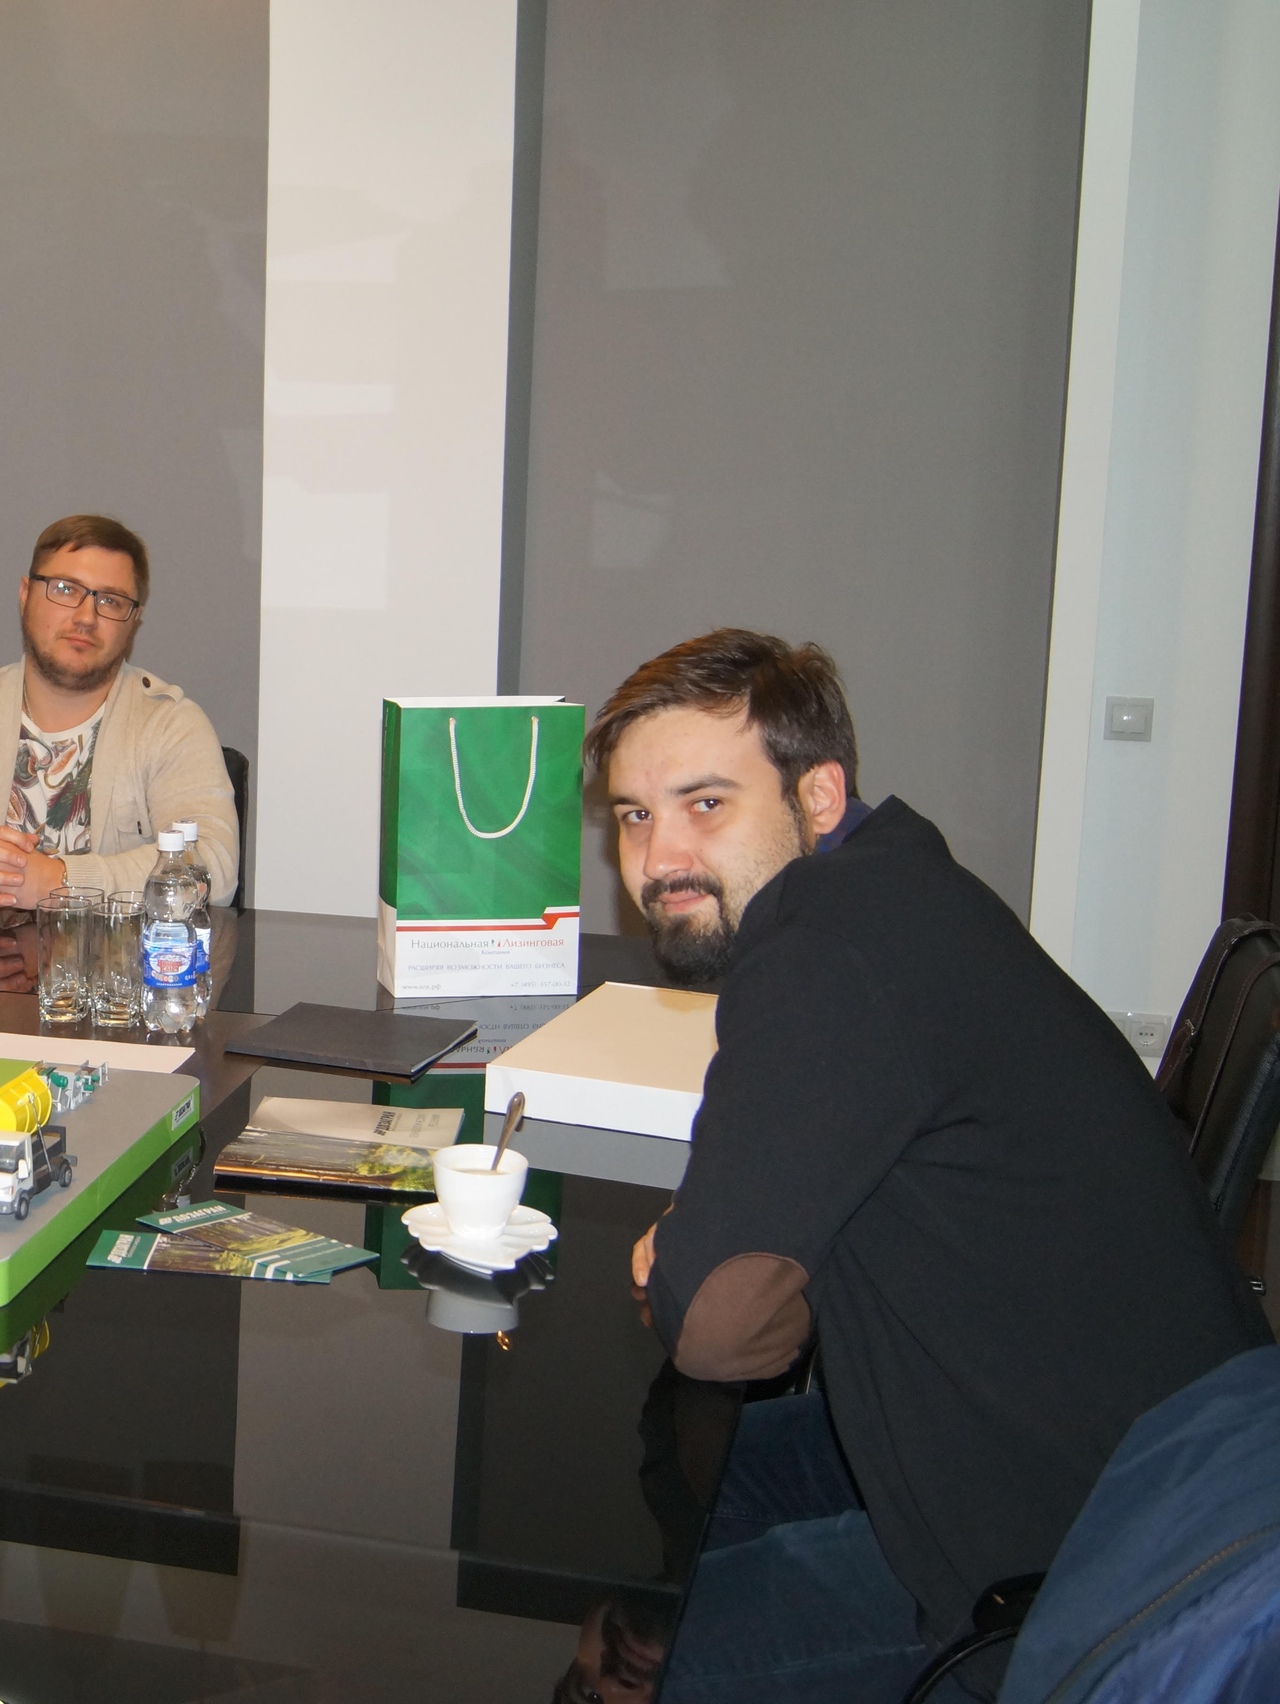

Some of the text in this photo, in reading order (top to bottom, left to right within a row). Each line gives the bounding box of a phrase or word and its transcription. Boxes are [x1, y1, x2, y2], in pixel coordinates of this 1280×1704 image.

[410, 938, 564, 950] Национальная Лизинговая
[446, 963, 503, 971] ВОЗМОЖНОСТИ
